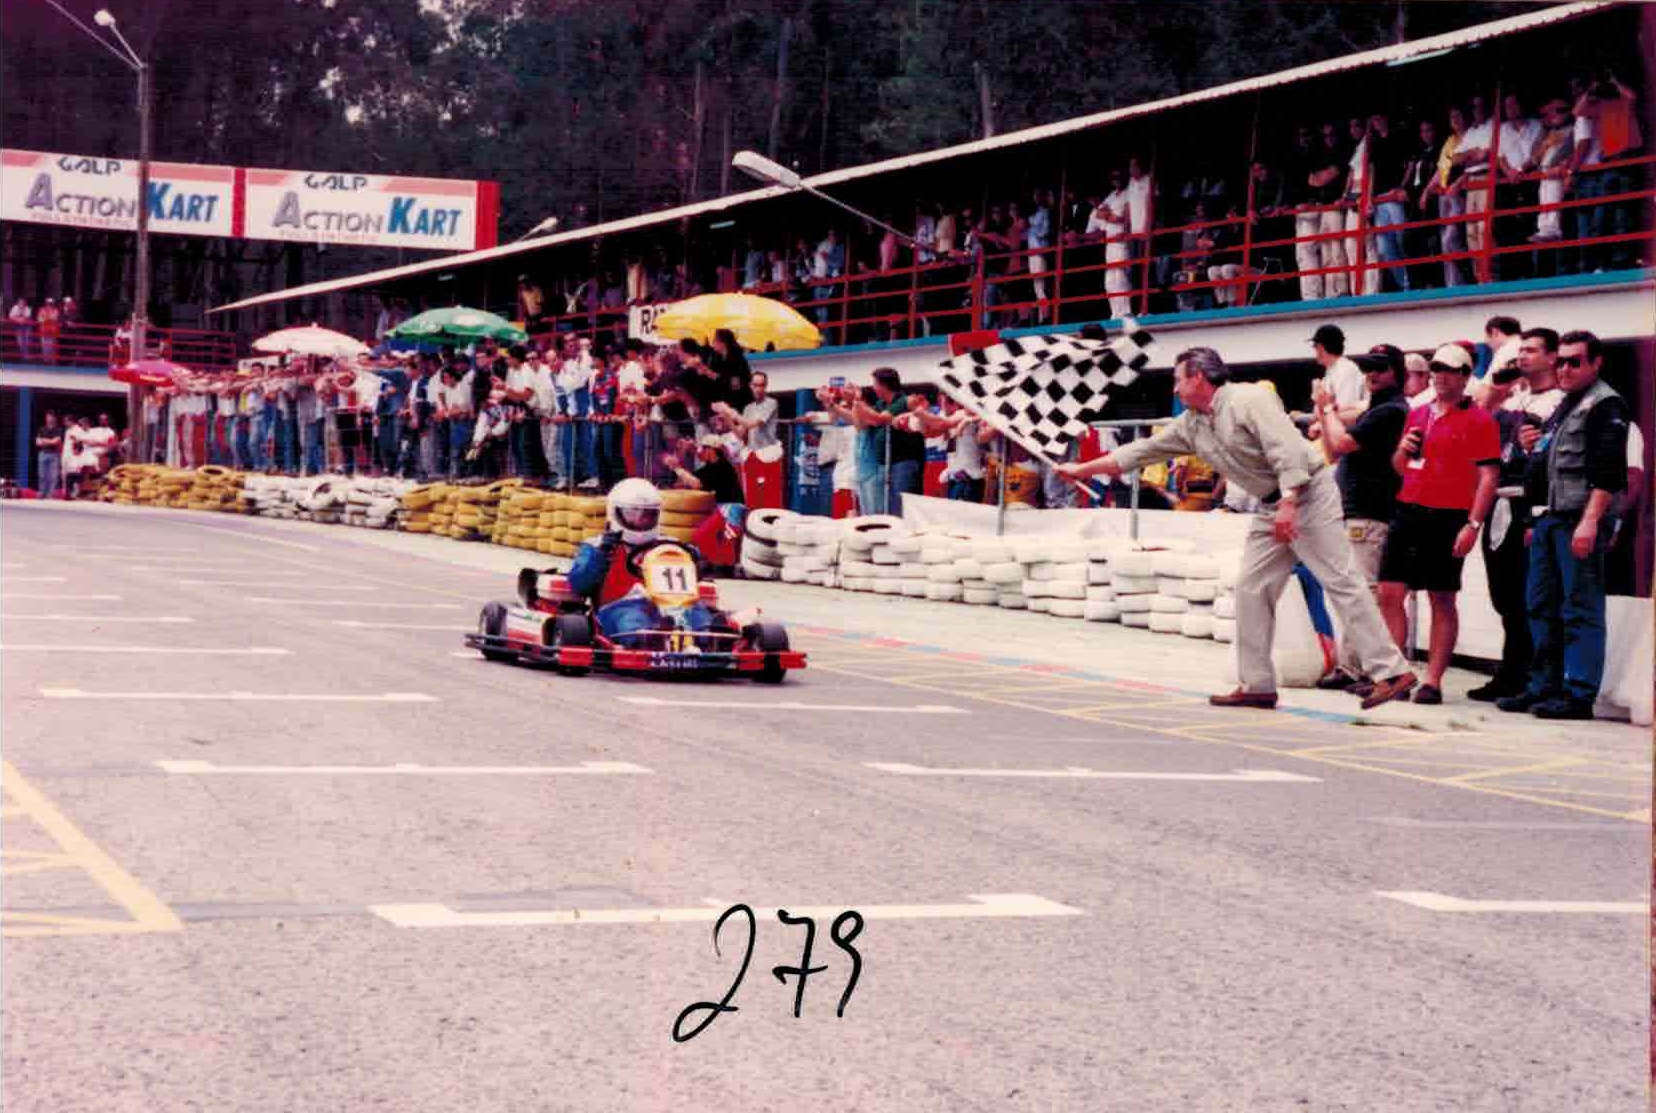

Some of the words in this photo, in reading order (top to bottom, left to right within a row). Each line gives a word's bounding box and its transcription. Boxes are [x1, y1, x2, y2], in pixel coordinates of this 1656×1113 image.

[57, 156, 121, 175] GALP
[304, 173, 367, 191] GALP
[24, 172, 137, 219] ACTION
[147, 180, 219, 223] KART
[271, 191, 384, 233] ACTION
[387, 195, 462, 236] KART
[661, 567, 686, 591] 11
